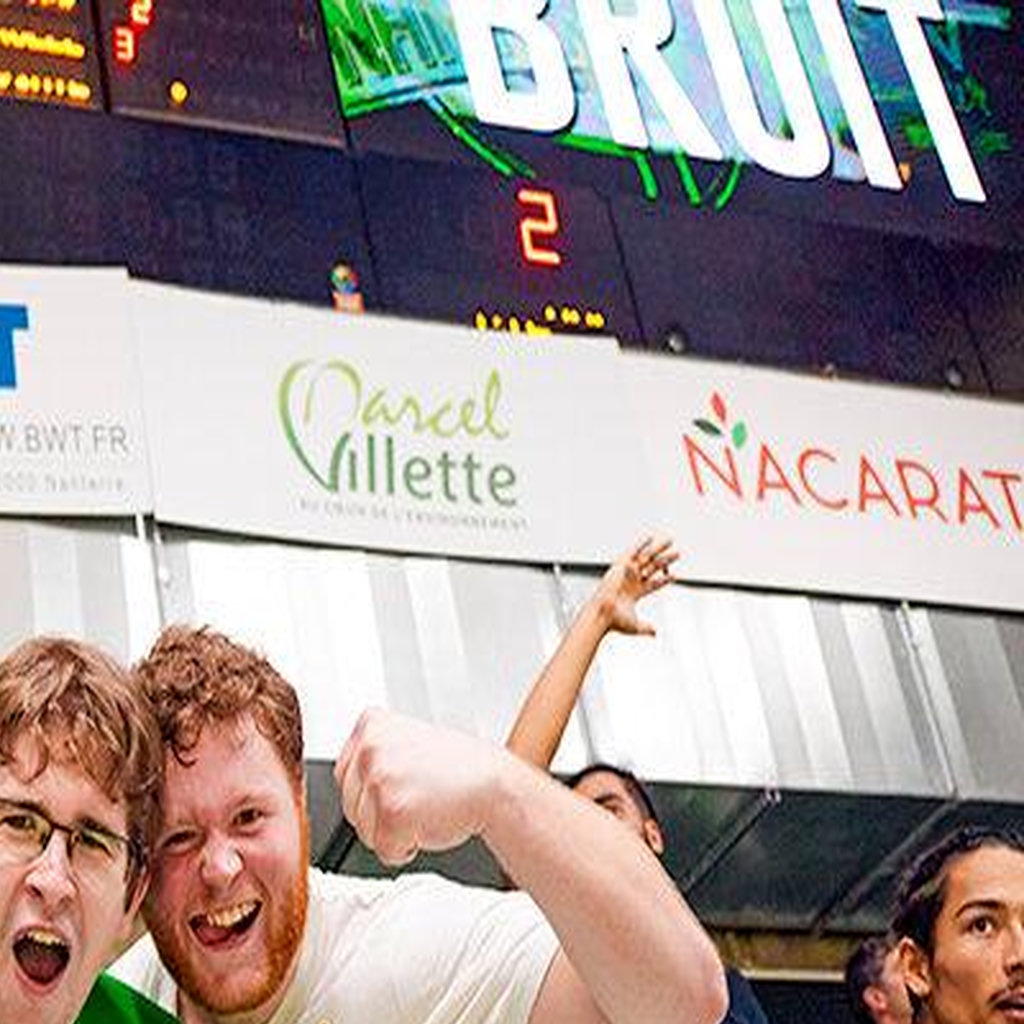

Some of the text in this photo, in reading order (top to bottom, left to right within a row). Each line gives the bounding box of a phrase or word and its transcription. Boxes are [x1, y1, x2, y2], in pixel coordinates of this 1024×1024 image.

[453, 0, 987, 203] BRUIT
[518, 188, 561, 265] 2
[288, 421, 517, 508] Villette
[682, 433, 1024, 532] NACARAT
